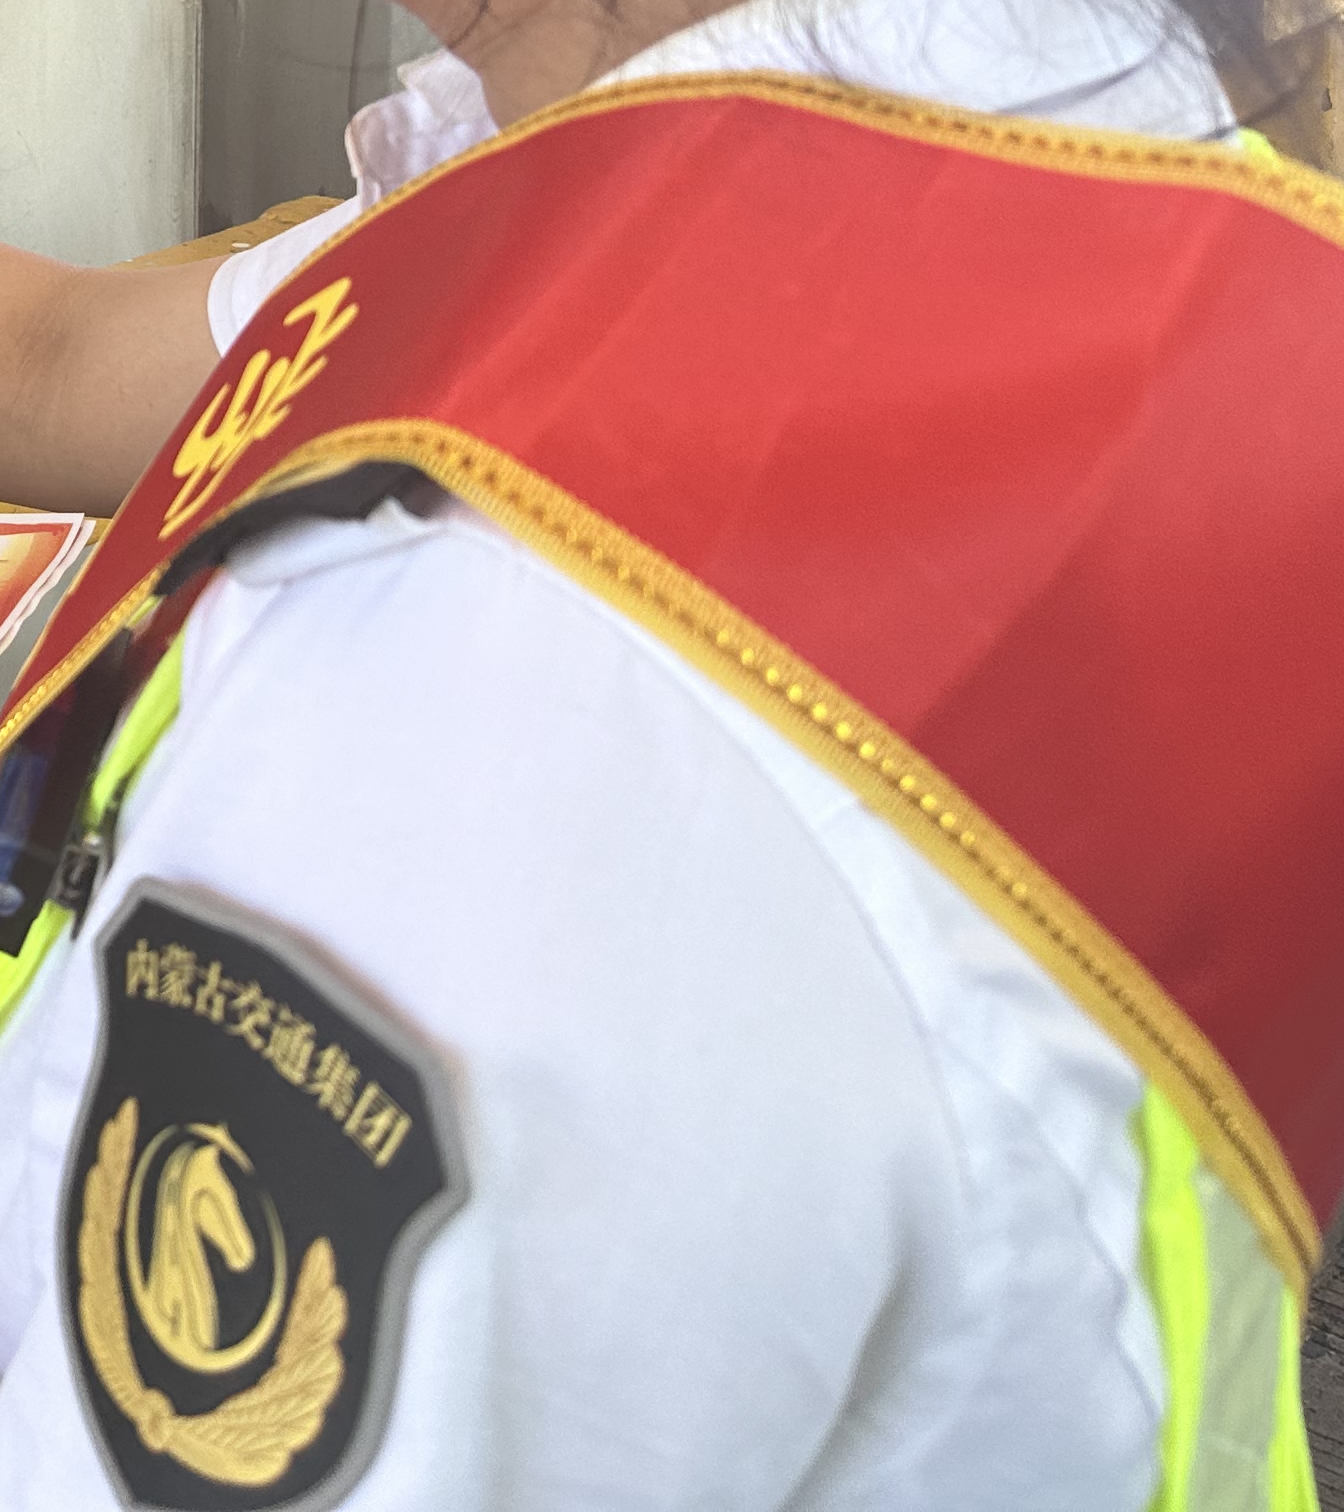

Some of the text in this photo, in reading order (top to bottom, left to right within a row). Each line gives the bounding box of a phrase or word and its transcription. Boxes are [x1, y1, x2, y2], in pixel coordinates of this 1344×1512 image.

[124, 937, 413, 1170] 内蒙古交通集团
